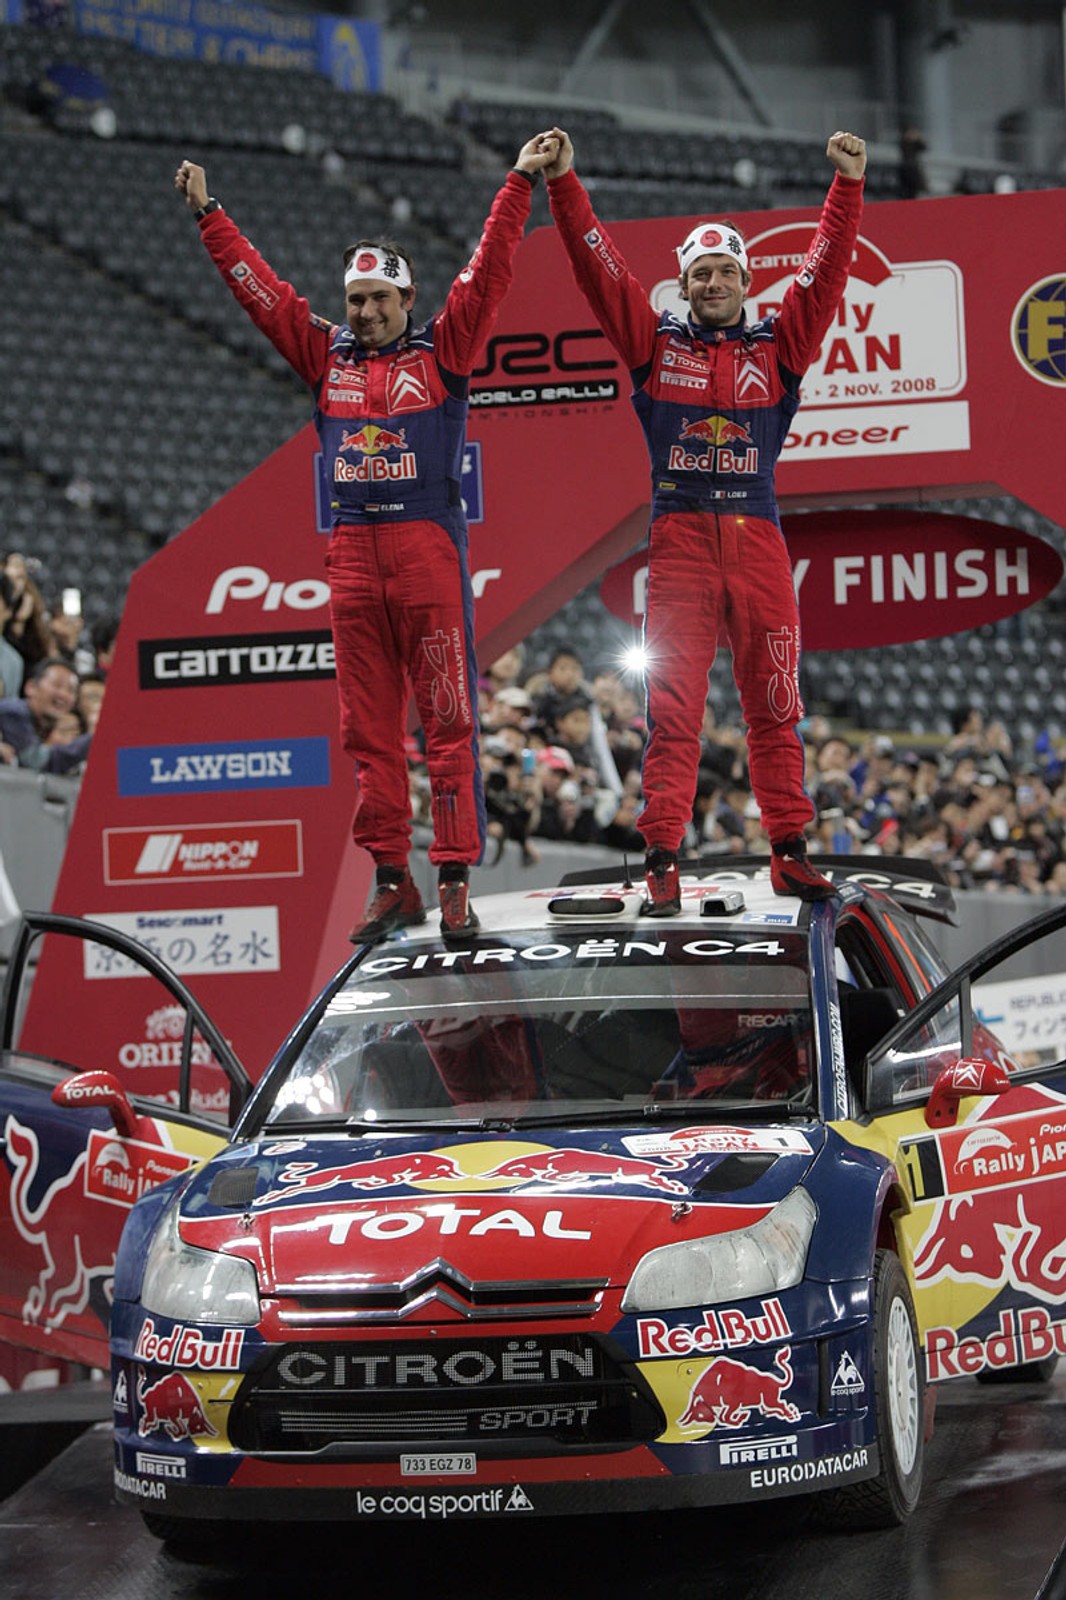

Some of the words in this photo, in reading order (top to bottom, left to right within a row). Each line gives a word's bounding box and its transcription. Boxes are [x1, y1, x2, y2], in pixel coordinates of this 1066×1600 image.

[600, 242, 620, 277] TOTAL
[246, 276, 272, 307] TOTAL
[676, 356, 710, 371] TOTAL
[828, 384, 839, 398] 2
[891, 377, 937, 394] 2008
[334, 456, 371, 483] Red
[371, 452, 418, 482] Bull
[668, 445, 716, 471] Red
[716, 447, 759, 475] Bull
[833, 547, 1030, 605] FINISH
[149, 750, 292, 784] LAWSON
[178, 840, 260, 862] NIPPON
[359, 938, 668, 974] CITROËN
[682, 939, 785, 956] C4
[64, 1085, 115, 1100] TOTAL
[972, 1152, 1026, 1177] Rally
[102, 1167, 136, 1196] Rally
[315, 1203, 592, 1245] TOTAL
[637, 1309, 723, 1358] Red
[720, 1297, 794, 1348] Bull
[134, 1318, 184, 1366] Red
[173, 1328, 246, 1371] Bull
[925, 1308, 1018, 1383] Red
[277, 1340, 595, 1385] CITROËN
[479, 1405, 598, 1431] SPORT
[136, 1451, 188, 1478] PIRELLI
[405, 1458, 427, 1472] 733
[429, 1457, 454, 1472] EGZ
[456, 1457, 473, 1471] 78
[719, 1434, 798, 1466] PIRELLI
[750, 1449, 869, 1489] EURODATACAR
[356, 1490, 377, 1514] le
[380, 1495, 426, 1519] coq
[429, 1488, 504, 1519] sportif
